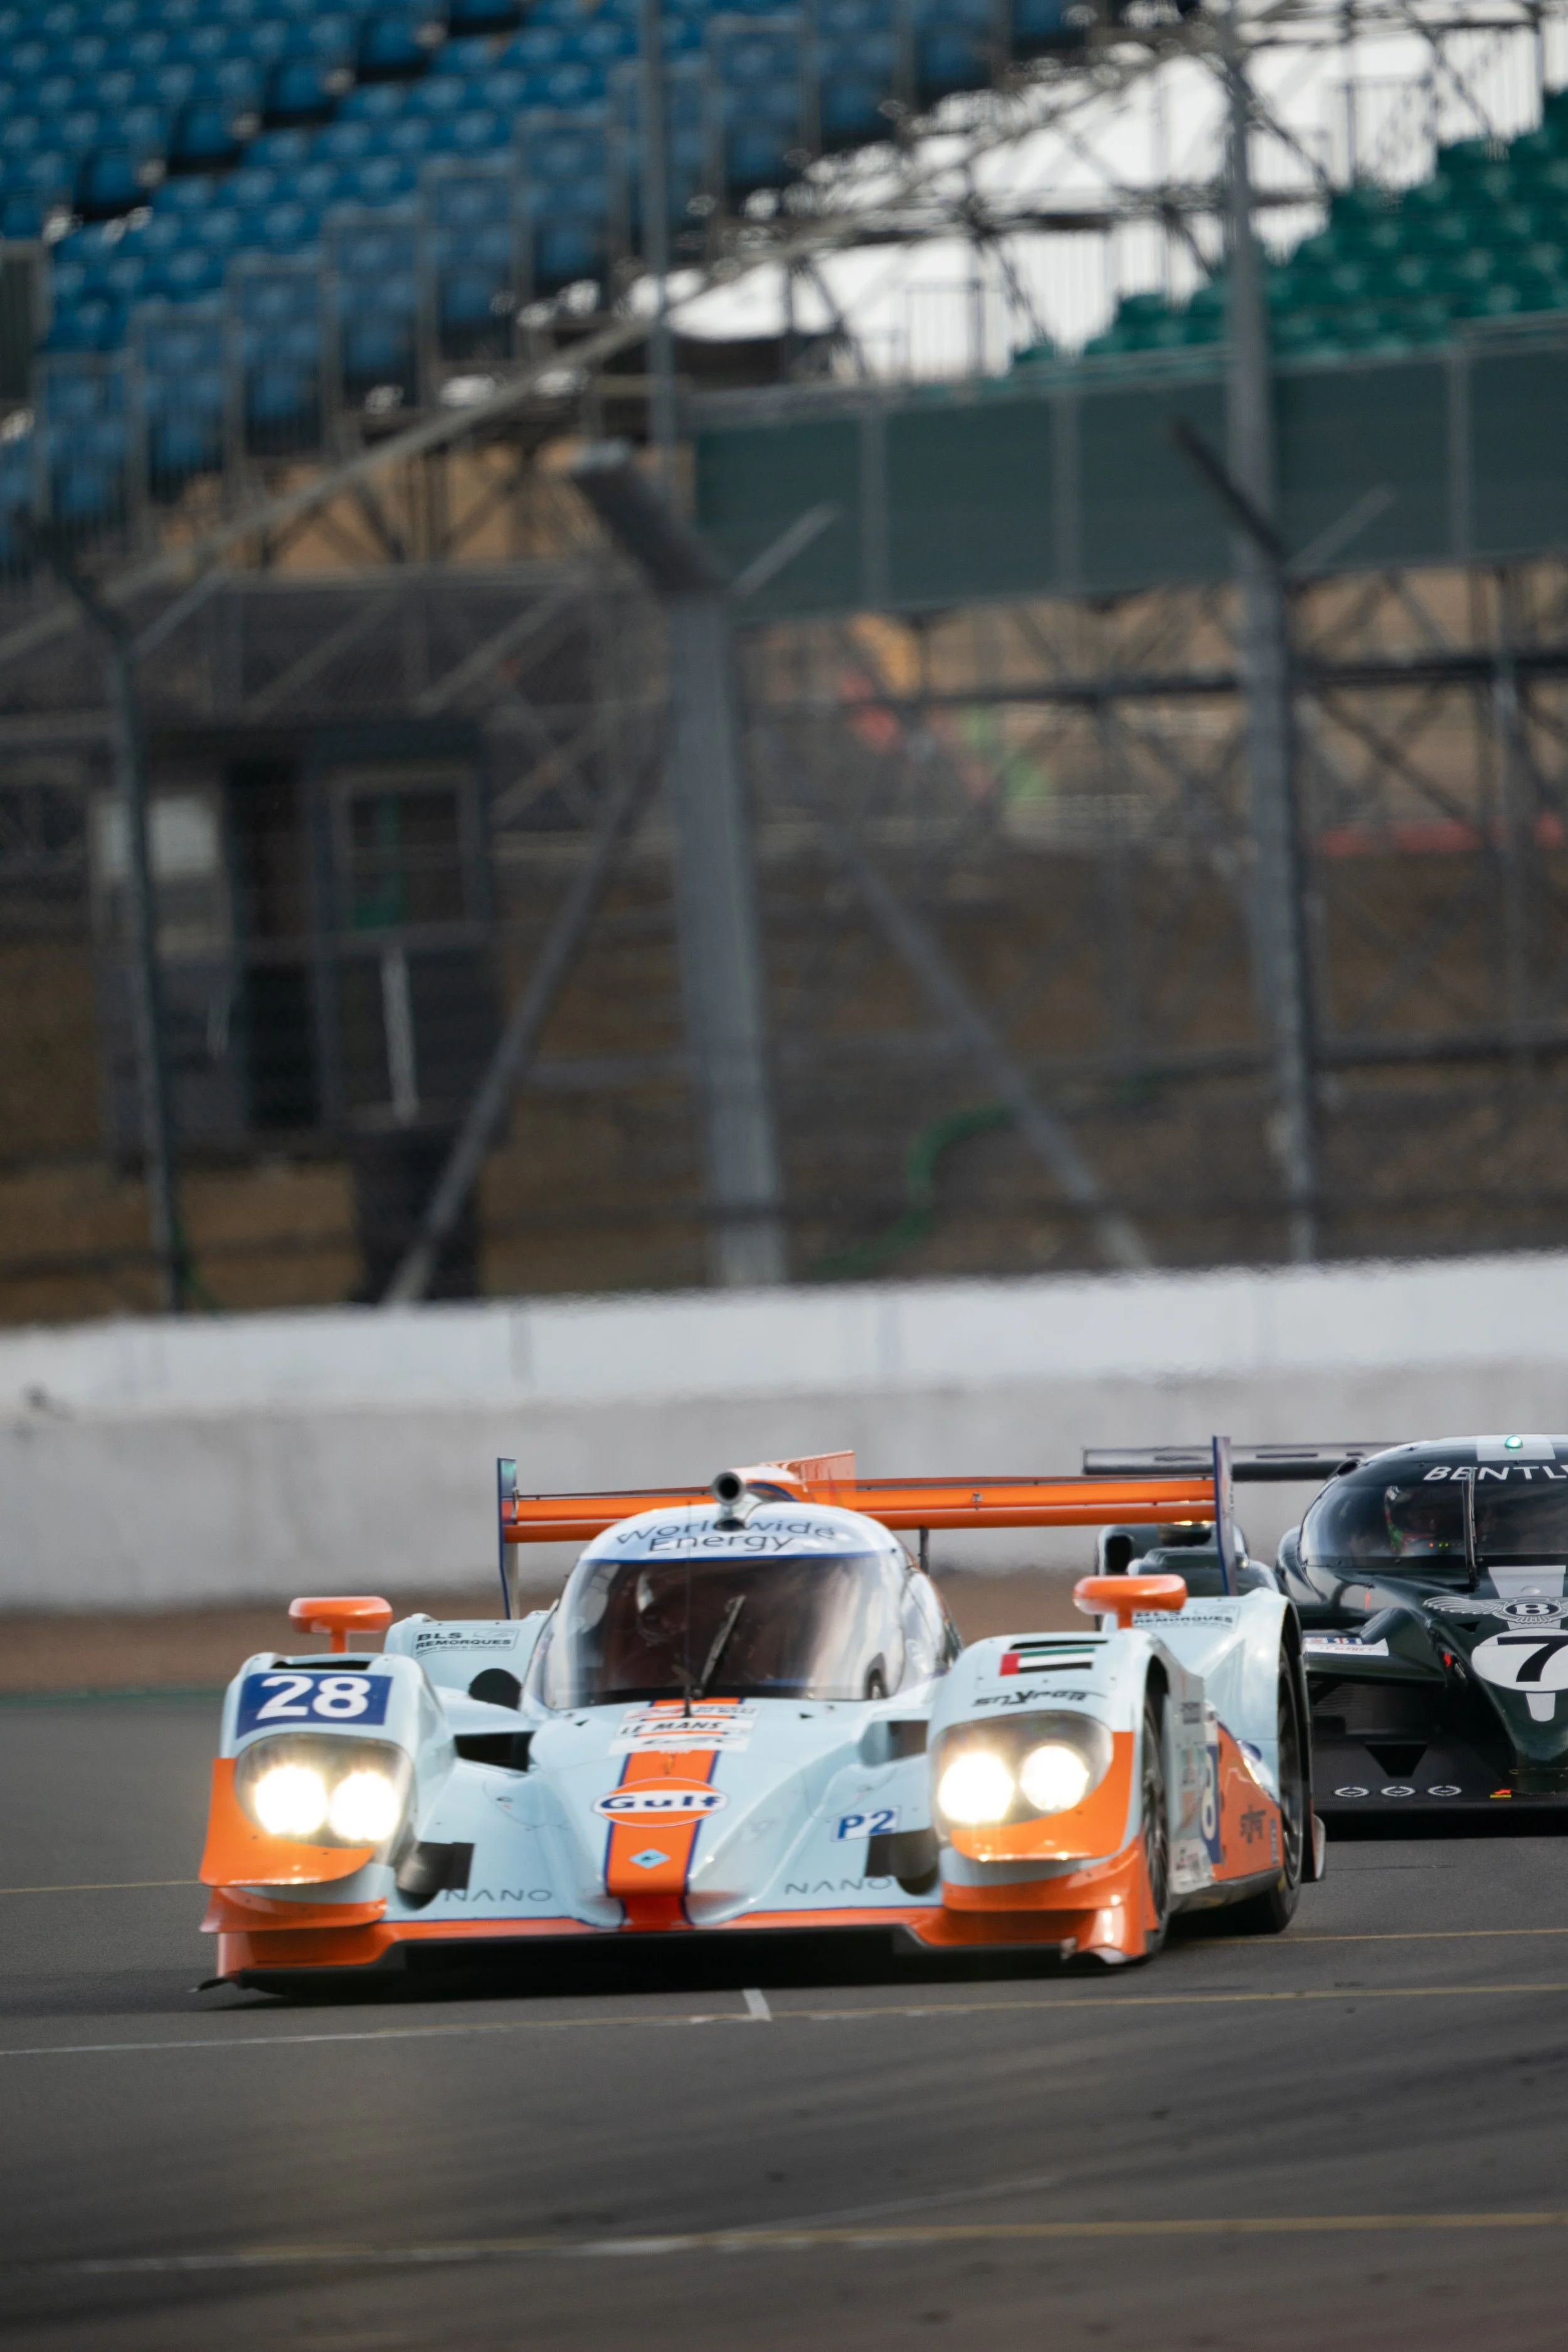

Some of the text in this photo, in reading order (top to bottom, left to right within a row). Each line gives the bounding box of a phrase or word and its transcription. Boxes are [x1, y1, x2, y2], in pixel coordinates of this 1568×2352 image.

[1422, 1465, 1568, 1481] BENTL
[649, 1535, 792, 1552] Energy
[1514, 1602, 1550, 1614] B
[417, 1632, 462, 1641] BLS
[415, 1640, 511, 1650] REMORQUES
[1496, 1635, 1568, 1683] 7
[255, 1675, 372, 1720] 28
[652, 1722, 723, 1732] MANS
[600, 1795, 722, 1809] Gulf
[837, 1810, 894, 1840] P2
[785, 1877, 892, 1895] NANO
[444, 1888, 553, 1902] NANO
